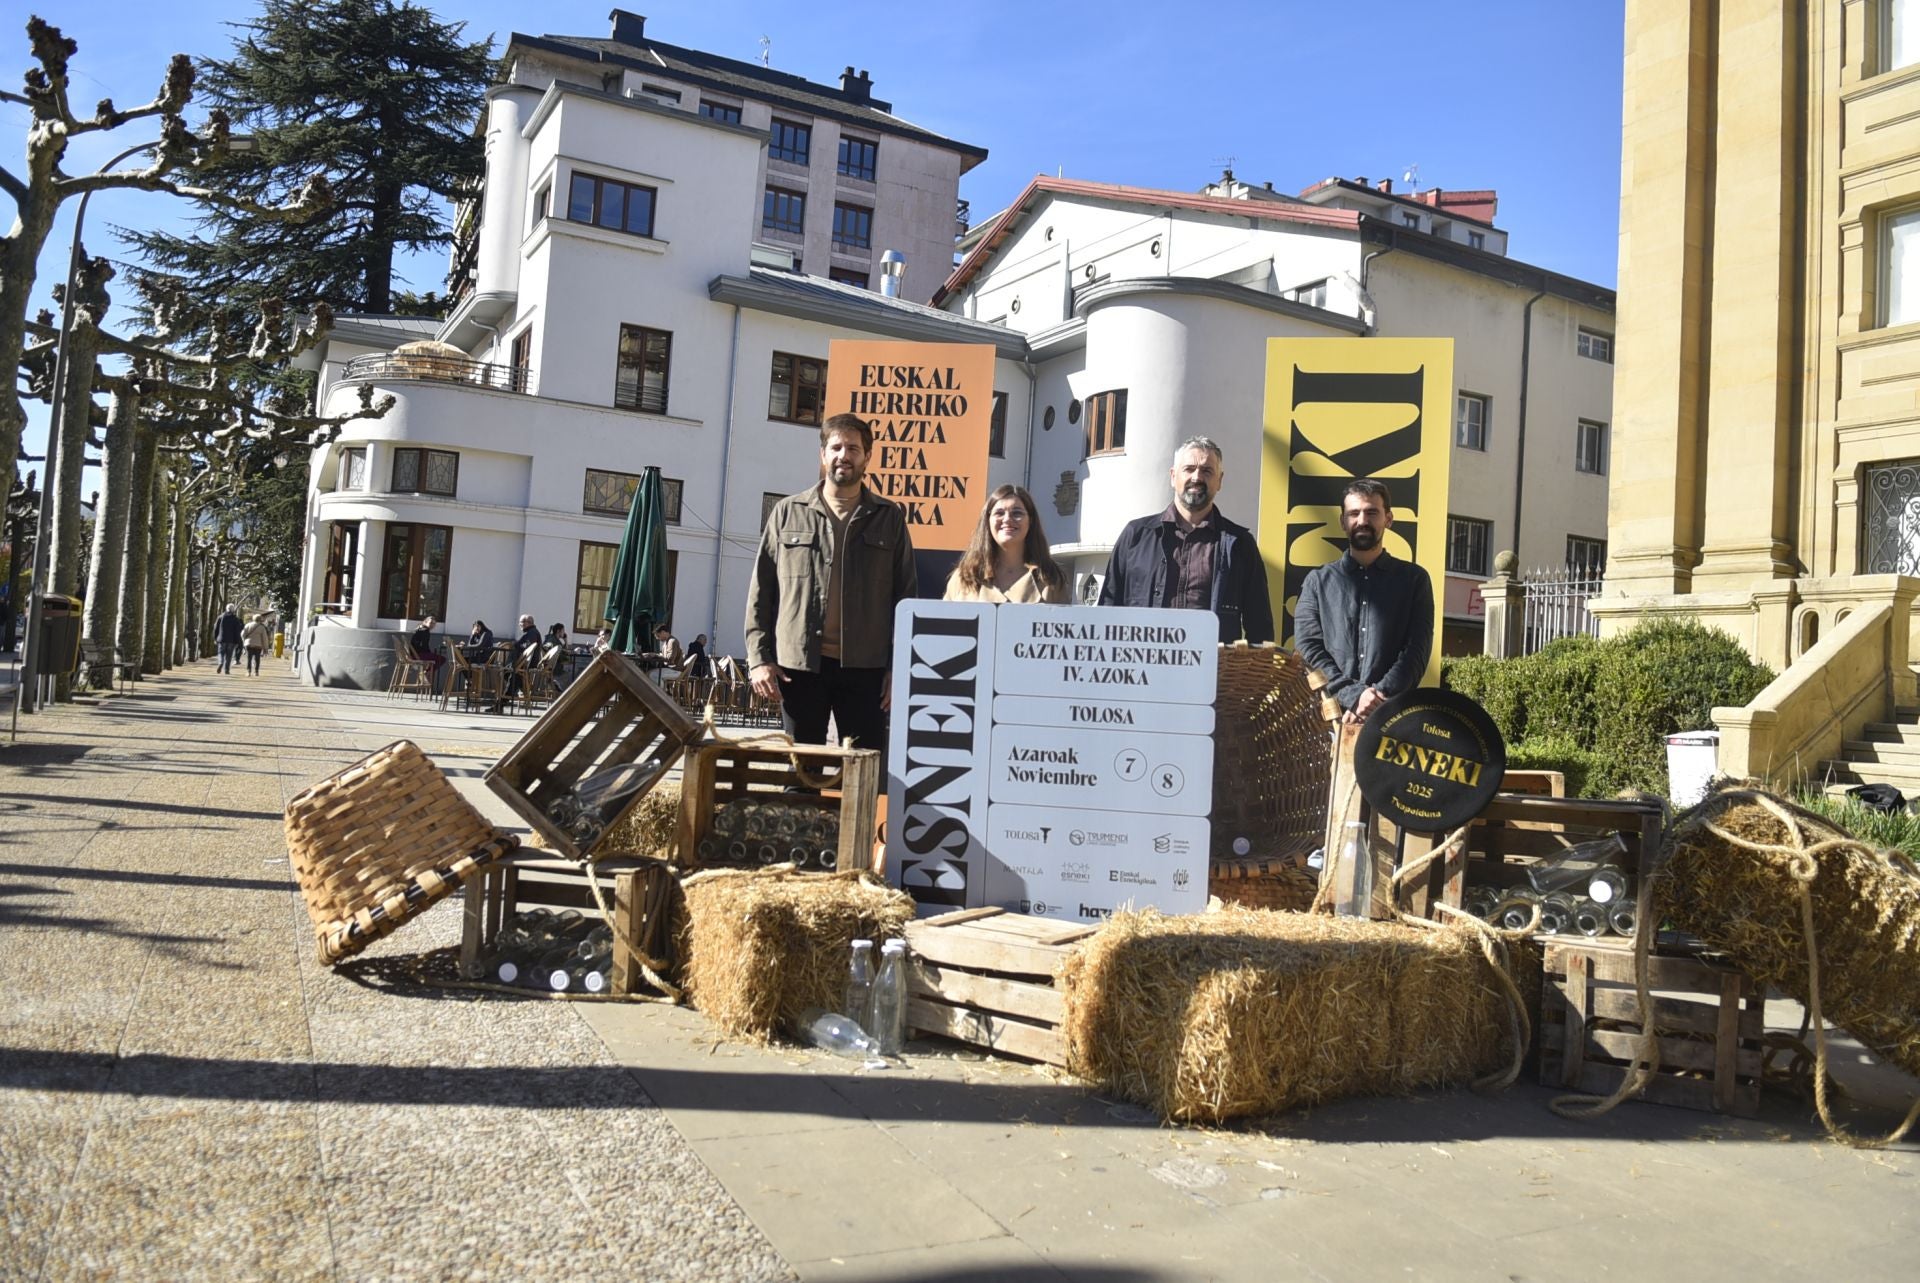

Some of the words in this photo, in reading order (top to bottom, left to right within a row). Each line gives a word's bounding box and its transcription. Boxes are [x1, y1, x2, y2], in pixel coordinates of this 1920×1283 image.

[859, 365, 961, 391] EUSKAL
[850, 391, 968, 418] HERRIKO
[867, 419, 946, 444] GAZTA
[879, 446, 928, 470] ETA
[862, 473, 970, 499] NEKIEN
[1031, 621, 1101, 641] EUSKAL
[1104, 624, 1187, 645] HERRIKO
[1013, 642, 1069, 662] GAZTA
[1073, 644, 1107, 663] ETA
[1111, 646, 1203, 668] ESNEKIEN
[1063, 665, 1085, 684] IV.
[1088, 666, 1149, 687] AZOKA
[1069, 704, 1135, 726] TOLOSA
[901, 611, 981, 912] ESNEKI
[1008, 744, 1079, 766] Azaroak
[1124, 757, 1136, 774] 7
[1375, 735, 1484, 788] ESNEKI
[1007, 766, 1098, 788] Noviembre
[1161, 773, 1174, 790] 8
[1406, 782, 1434, 799] 2025
